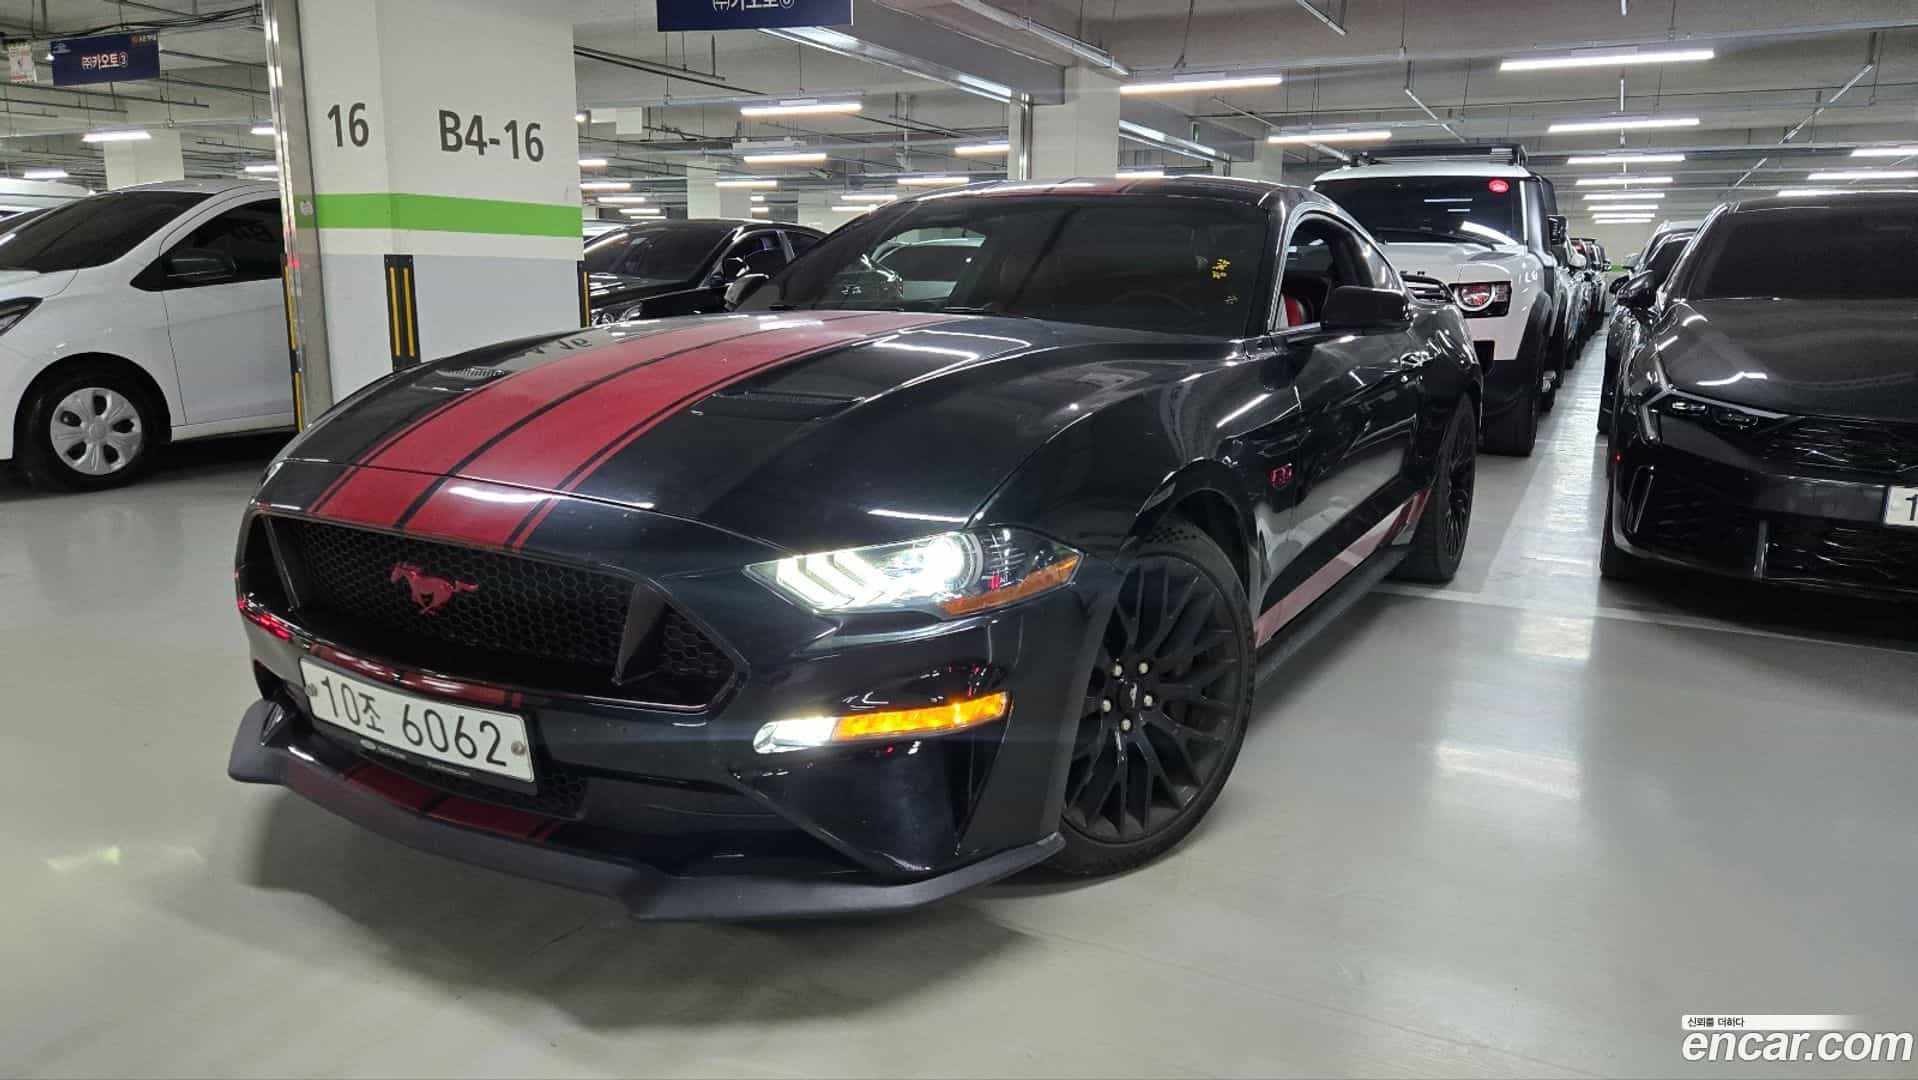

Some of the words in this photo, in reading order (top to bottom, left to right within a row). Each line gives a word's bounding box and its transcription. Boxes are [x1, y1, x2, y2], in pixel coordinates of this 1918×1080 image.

[327, 102, 369, 147] 16
[438, 109, 544, 162] B4-16
[321, 676, 384, 734] 10조
[402, 704, 507, 767] 6062
